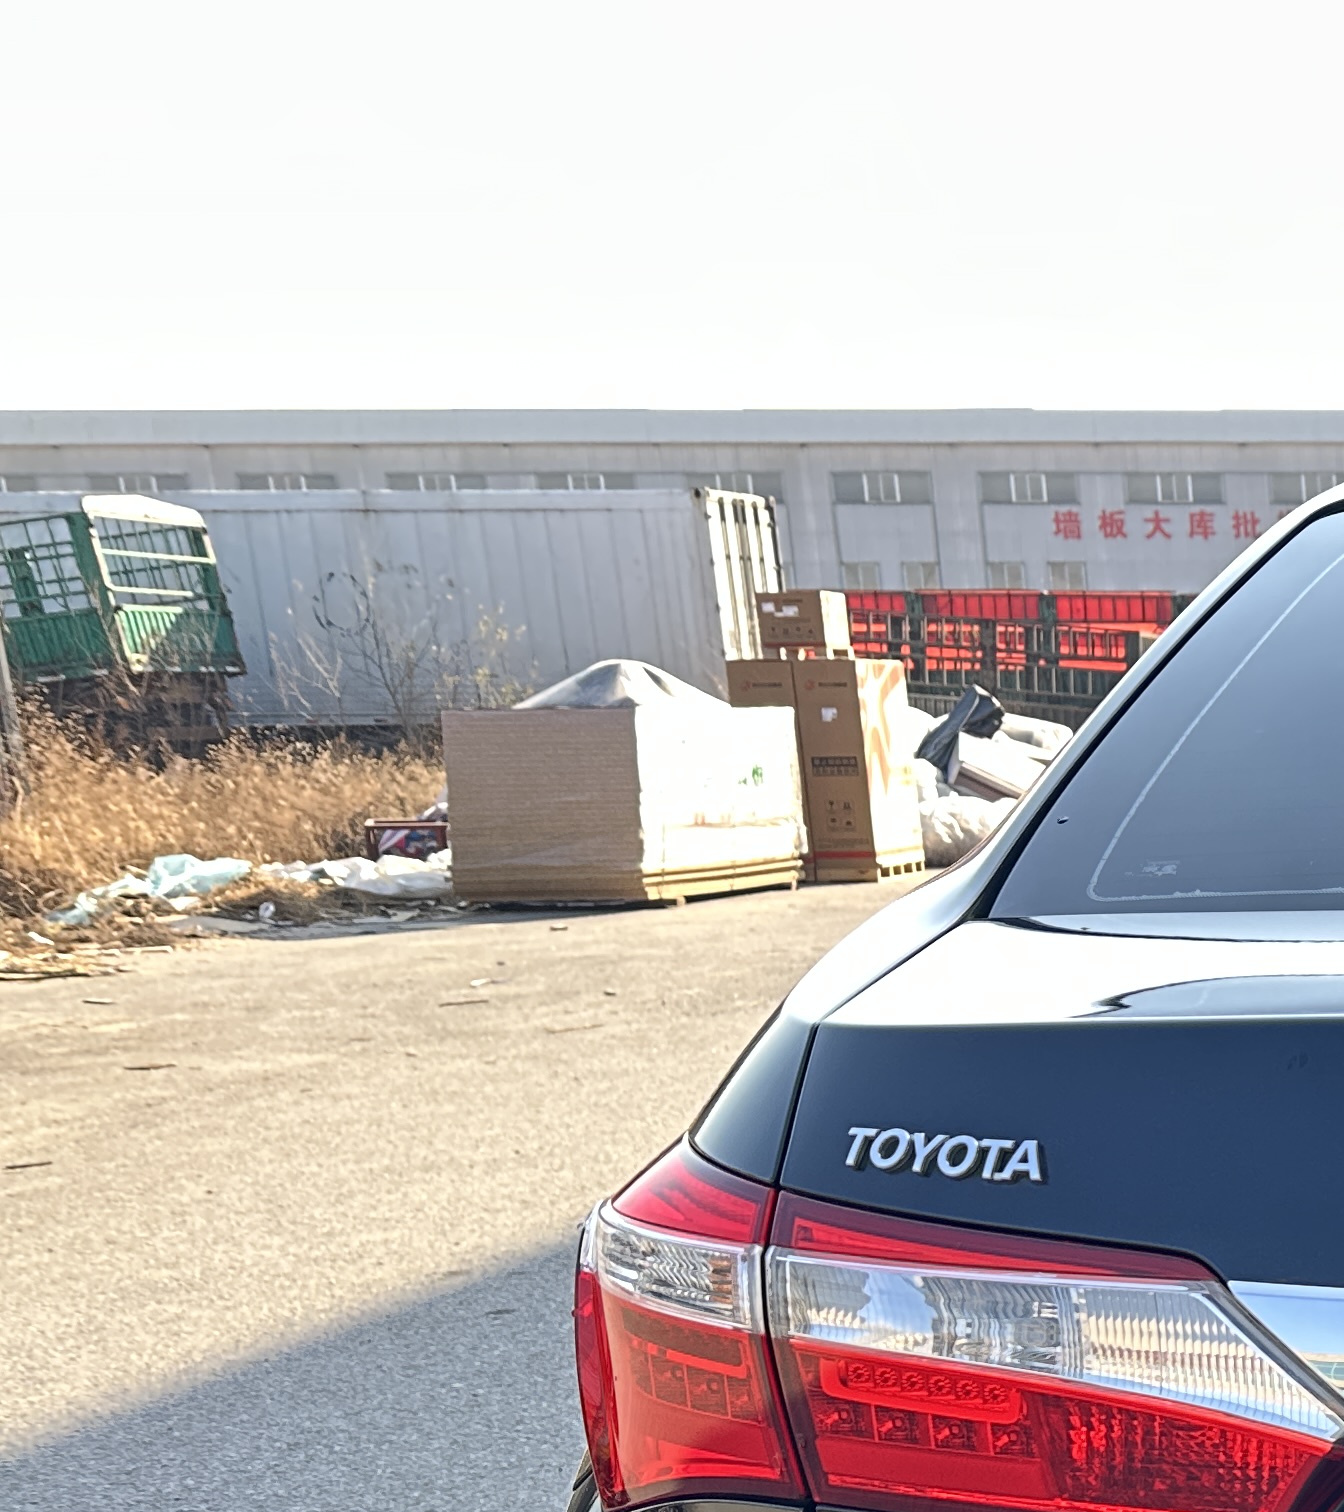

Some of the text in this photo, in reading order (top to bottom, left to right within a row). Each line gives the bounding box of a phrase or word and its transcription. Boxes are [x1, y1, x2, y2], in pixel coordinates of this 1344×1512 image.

[1052, 509, 1292, 540] 墙板大库批
[845, 1127, 1043, 1182] TOYOTA
